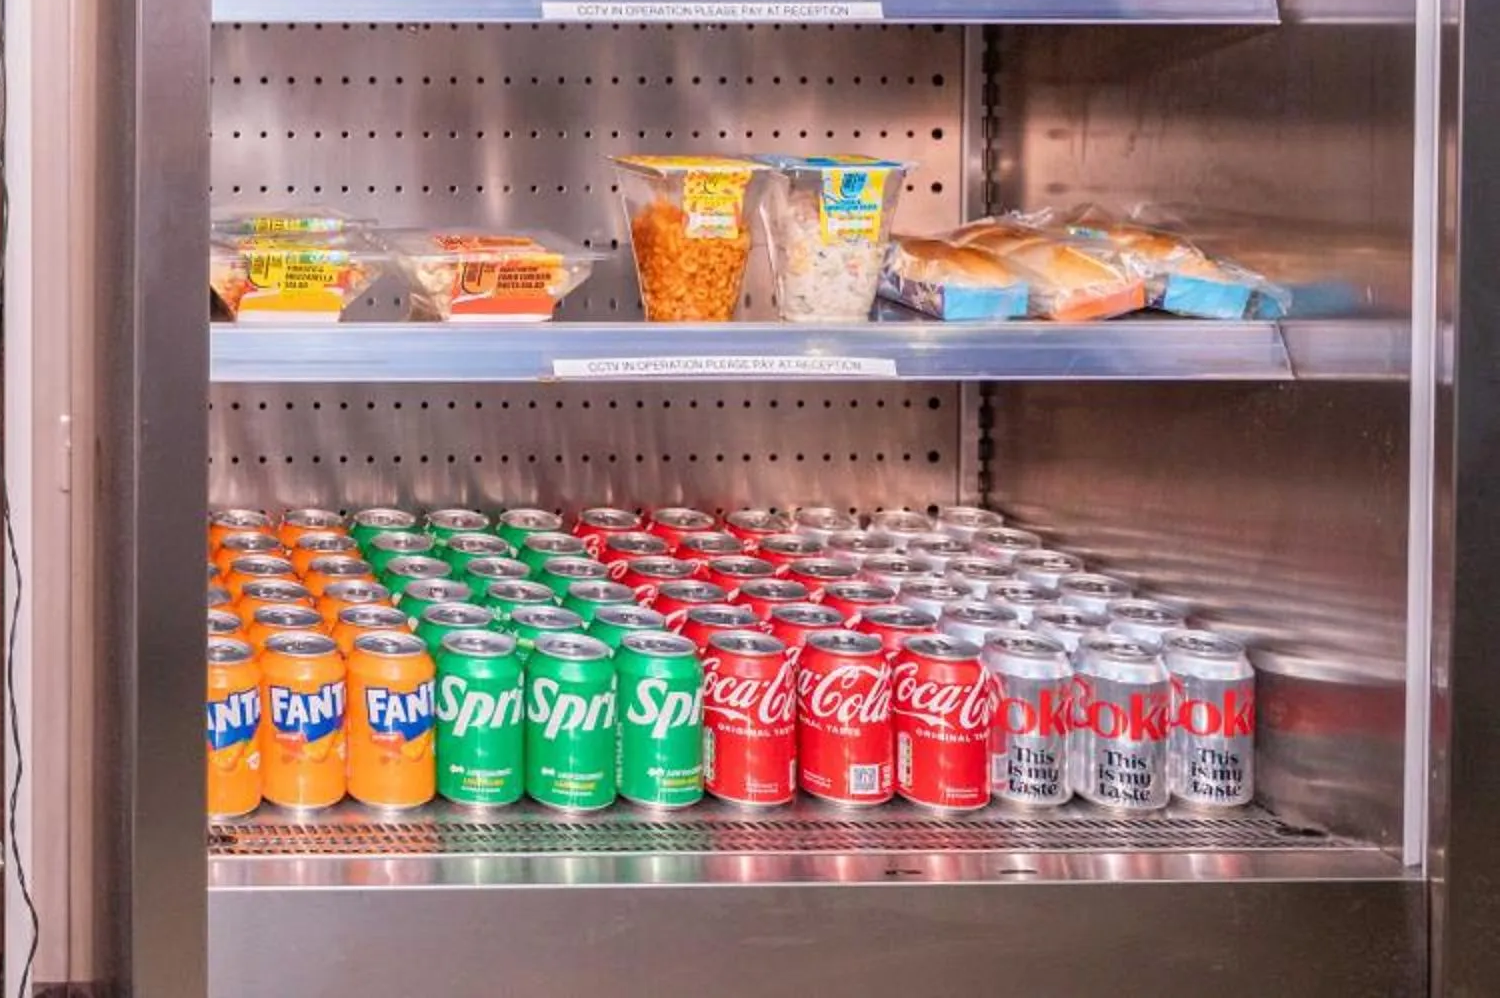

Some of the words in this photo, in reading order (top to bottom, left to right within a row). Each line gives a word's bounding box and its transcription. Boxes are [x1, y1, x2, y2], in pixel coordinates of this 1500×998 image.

[269, 680, 346, 726] FANT
[366, 678, 435, 726] FANT
[437, 672, 524, 737] Spri
[528, 672, 617, 740] Spri
[627, 677, 704, 739] Spr
[1014, 745, 1054, 765] This
[1103, 748, 1147, 769] This
[1197, 747, 1239, 765] This
[1007, 762, 1022, 777] is
[1027, 766, 1059, 783] my
[1099, 766, 1113, 781] is
[1120, 771, 1152, 788] my
[1190, 762, 1205, 777] is
[1211, 766, 1243, 783] my
[1009, 779, 1059, 796] taste
[1099, 782, 1151, 801] taste
[1190, 780, 1241, 798] taste
